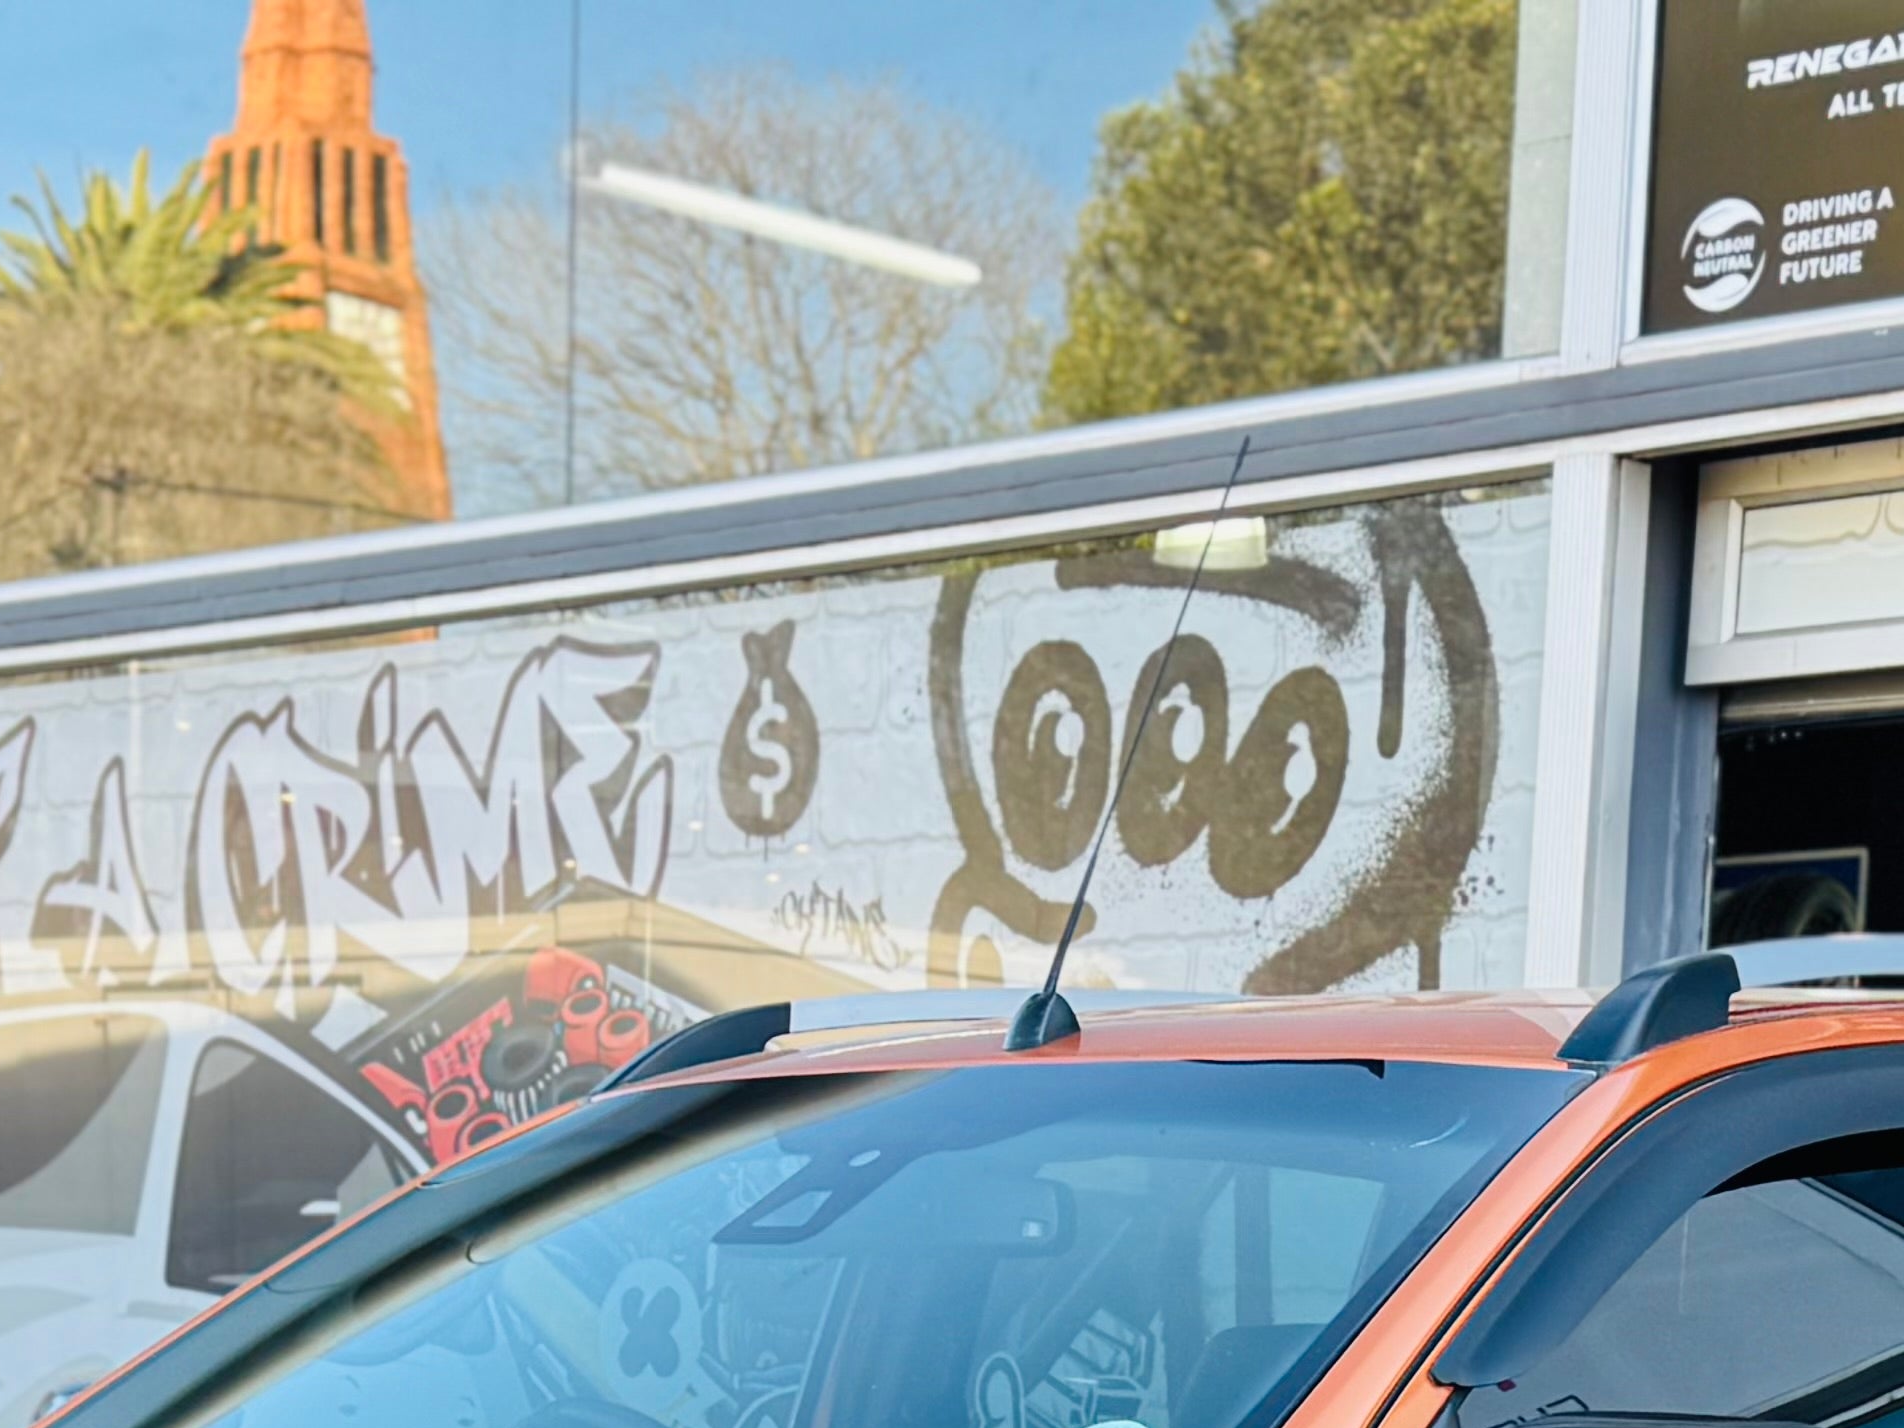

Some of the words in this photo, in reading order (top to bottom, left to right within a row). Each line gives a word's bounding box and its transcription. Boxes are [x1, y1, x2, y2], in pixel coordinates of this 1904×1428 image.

[1827, 88, 1874, 120] ALL
[1782, 189, 1873, 227] DRIVING
[1876, 185, 1895, 210] A
[1694, 234, 1756, 260] CARBON
[1780, 218, 1878, 256] GREENER
[1692, 252, 1755, 278] NEUTRAL
[1778, 249, 1864, 286] FUTURE
[184, 634, 674, 998] CRIME
